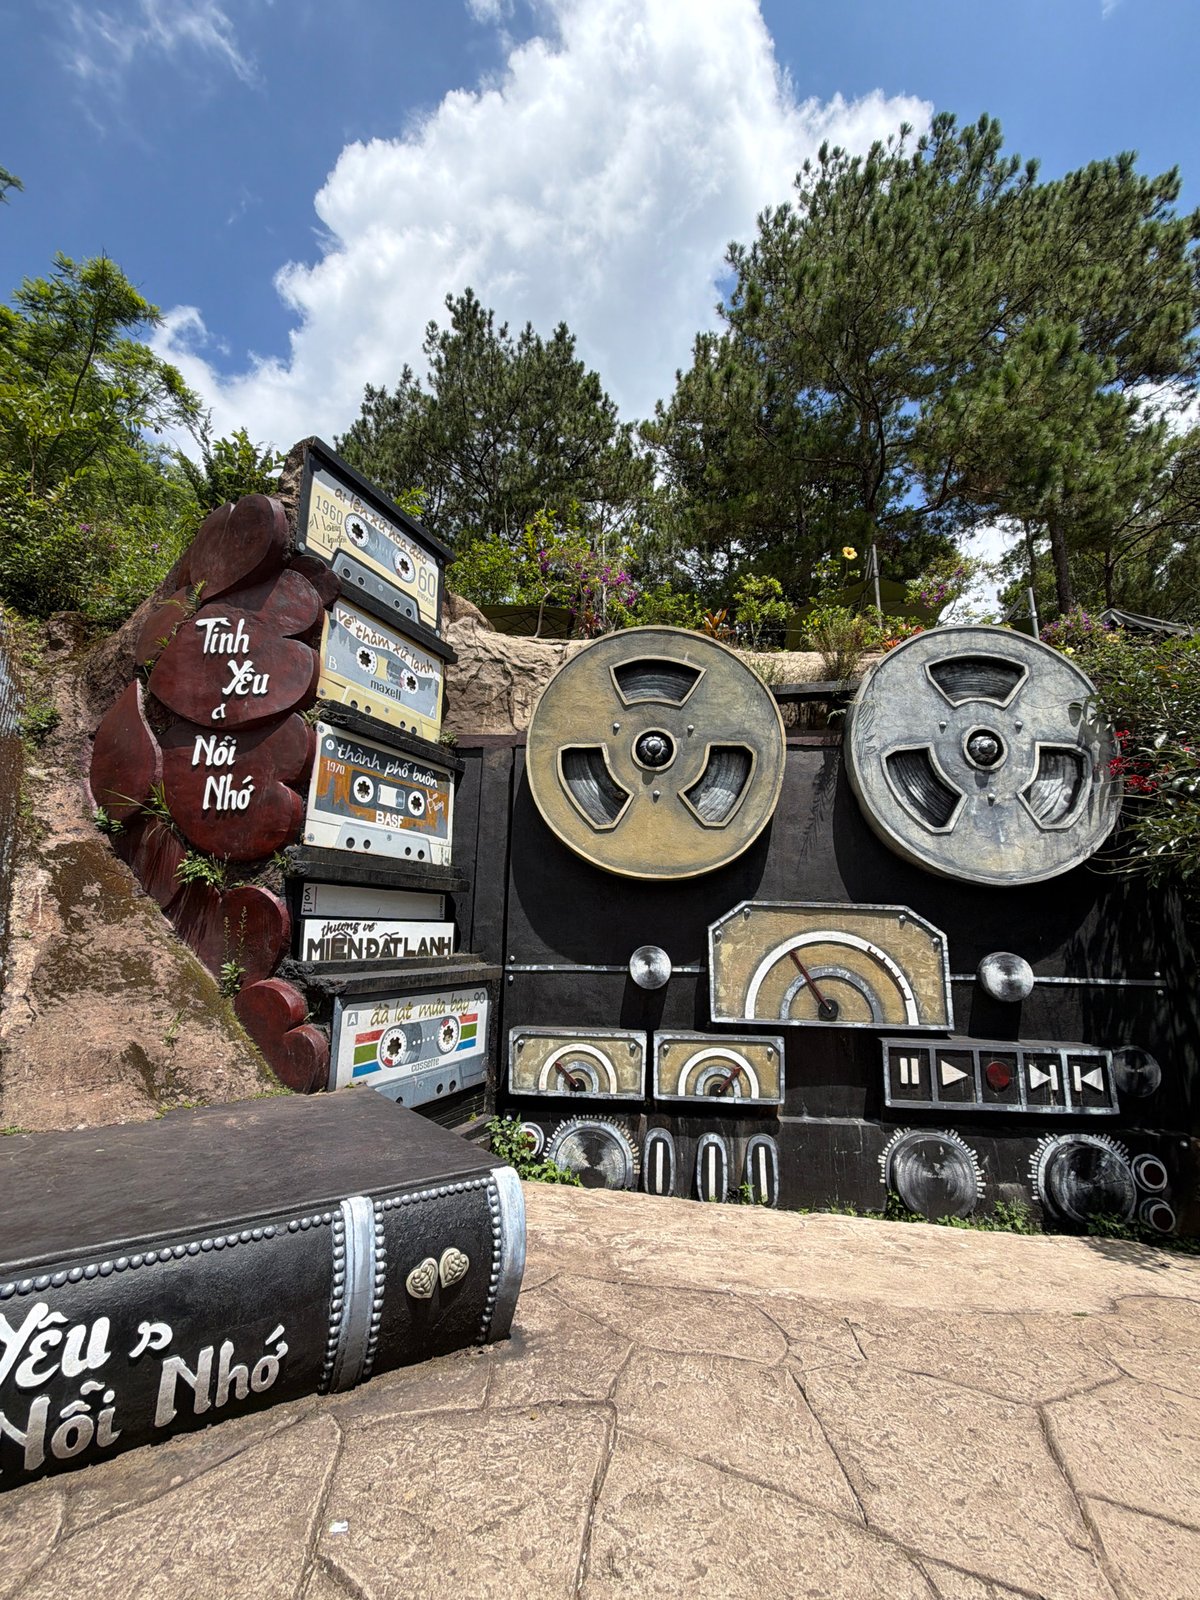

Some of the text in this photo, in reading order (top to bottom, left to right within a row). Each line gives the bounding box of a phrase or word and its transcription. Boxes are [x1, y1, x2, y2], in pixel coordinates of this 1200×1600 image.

[316, 495, 343, 526] 1960
[419, 566, 436, 598] 60
[328, 656, 338, 671] B
[355, 626, 391, 650] thăm
[410, 653, 434, 674] lạnh
[221, 659, 270, 695] Yêu
[370, 679, 402, 701] maxell
[429, 706, 436, 718] A
[326, 760, 345, 775] 1970
[337, 744, 438, 788] thành phố buồn
[202, 773, 255, 811] Nhớ
[375, 811, 404, 828] BASF
[303, 887, 313, 914] vol.1
[450, 993, 470, 1016] bay
[474, 992, 486, 1006] 90
[348, 1013, 358, 1026] A
[0, 1302, 111, 1388] Yêu
[154, 1324, 289, 1427] Nhớ
